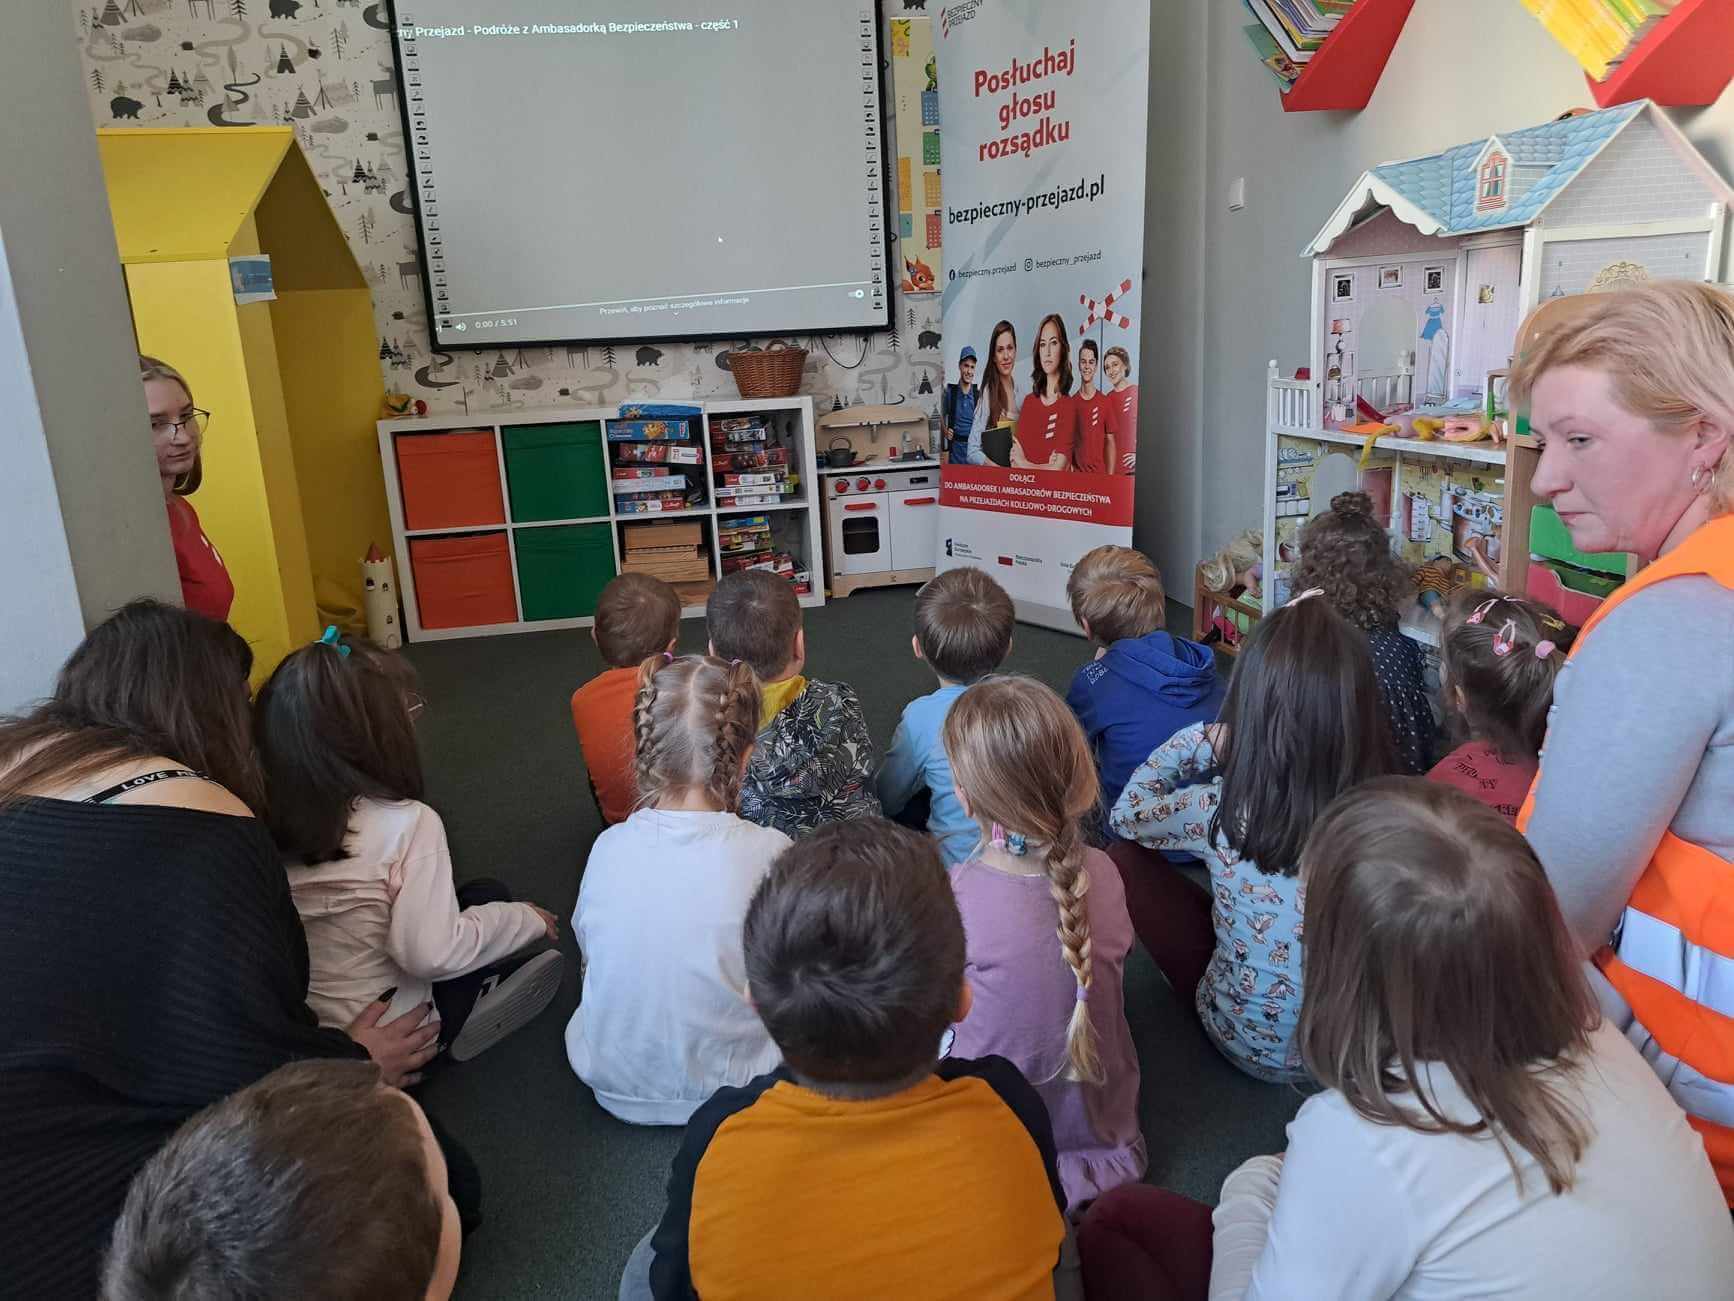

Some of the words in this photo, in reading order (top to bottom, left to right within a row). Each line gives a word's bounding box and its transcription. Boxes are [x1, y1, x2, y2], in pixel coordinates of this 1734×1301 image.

[415, 25, 464, 38] Przejazd
[474, 24, 520, 35] Podróże
[522, 26, 529, 34] z
[531, 22, 607, 35] Ambasadorką
[609, 20, 693, 34] Bezpieczeństwa
[700, 19, 731, 32] część
[733, 19, 738, 29] 1
[974, 39, 1075, 97] Posłuchaj
[999, 90, 1055, 131] głosu
[979, 118, 1070, 161] rozsądku
[949, 174, 1105, 225] bezpieczny-przejazd.pl
[944, 481, 953, 489] DO
[953, 482, 998, 493] AMBASADOREK
[1002, 486, 1052, 498] AMBASADORÓW
[1053, 490, 1111, 504] BEZPIECZEŃSTWA
[1009, 473, 1035, 484] DOŁĄCZ
[121, 771, 168, 790] LOVE
